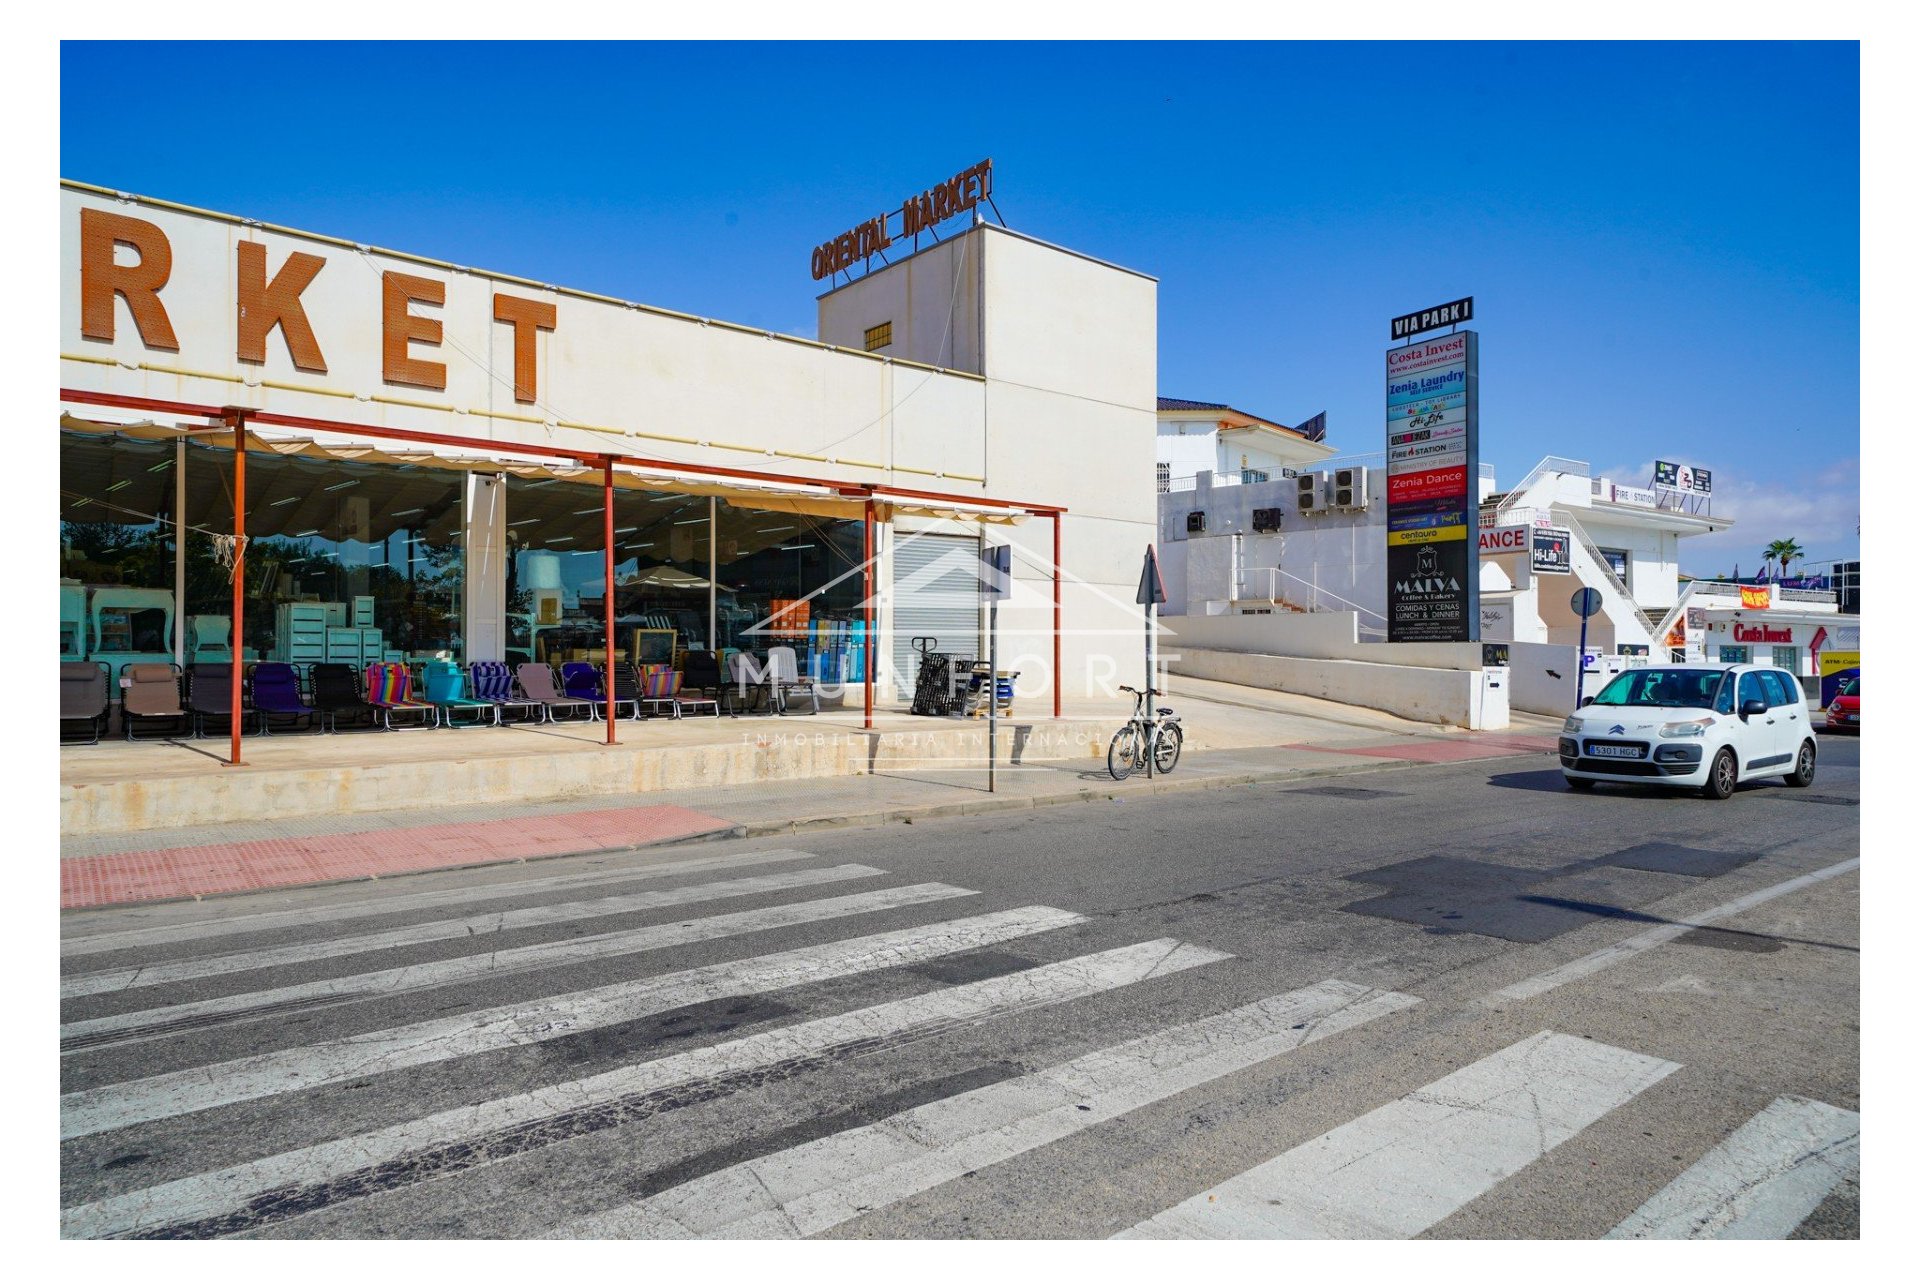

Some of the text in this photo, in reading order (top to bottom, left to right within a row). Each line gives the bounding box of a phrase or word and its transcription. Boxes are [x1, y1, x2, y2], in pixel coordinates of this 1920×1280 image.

[811, 157, 993, 281] ORIENTAL MARKET
[81, 207, 557, 402] RKET
[1395, 301, 1469, 336] VIA PARK I
[1389, 339, 1464, 365] Costa Invest
[1390, 352, 1464, 374] www.costainvest.com
[1390, 371, 1464, 395] Zenia Laundry
[1415, 444, 1447, 455] STATION
[1438, 455, 1464, 464] BEAUTY
[1392, 472, 1462, 489] Zenia Dance
[1615, 489, 1629, 500] FIRE
[1400, 530, 1437, 540] centauro
[1534, 548, 1557, 562] Hi-Life
[1394, 577, 1460, 593] MALVA
[1395, 604, 1427, 612] COMIDAS
[1435, 603, 1460, 611] CENAS
[1596, 747, 1617, 755] 5301
